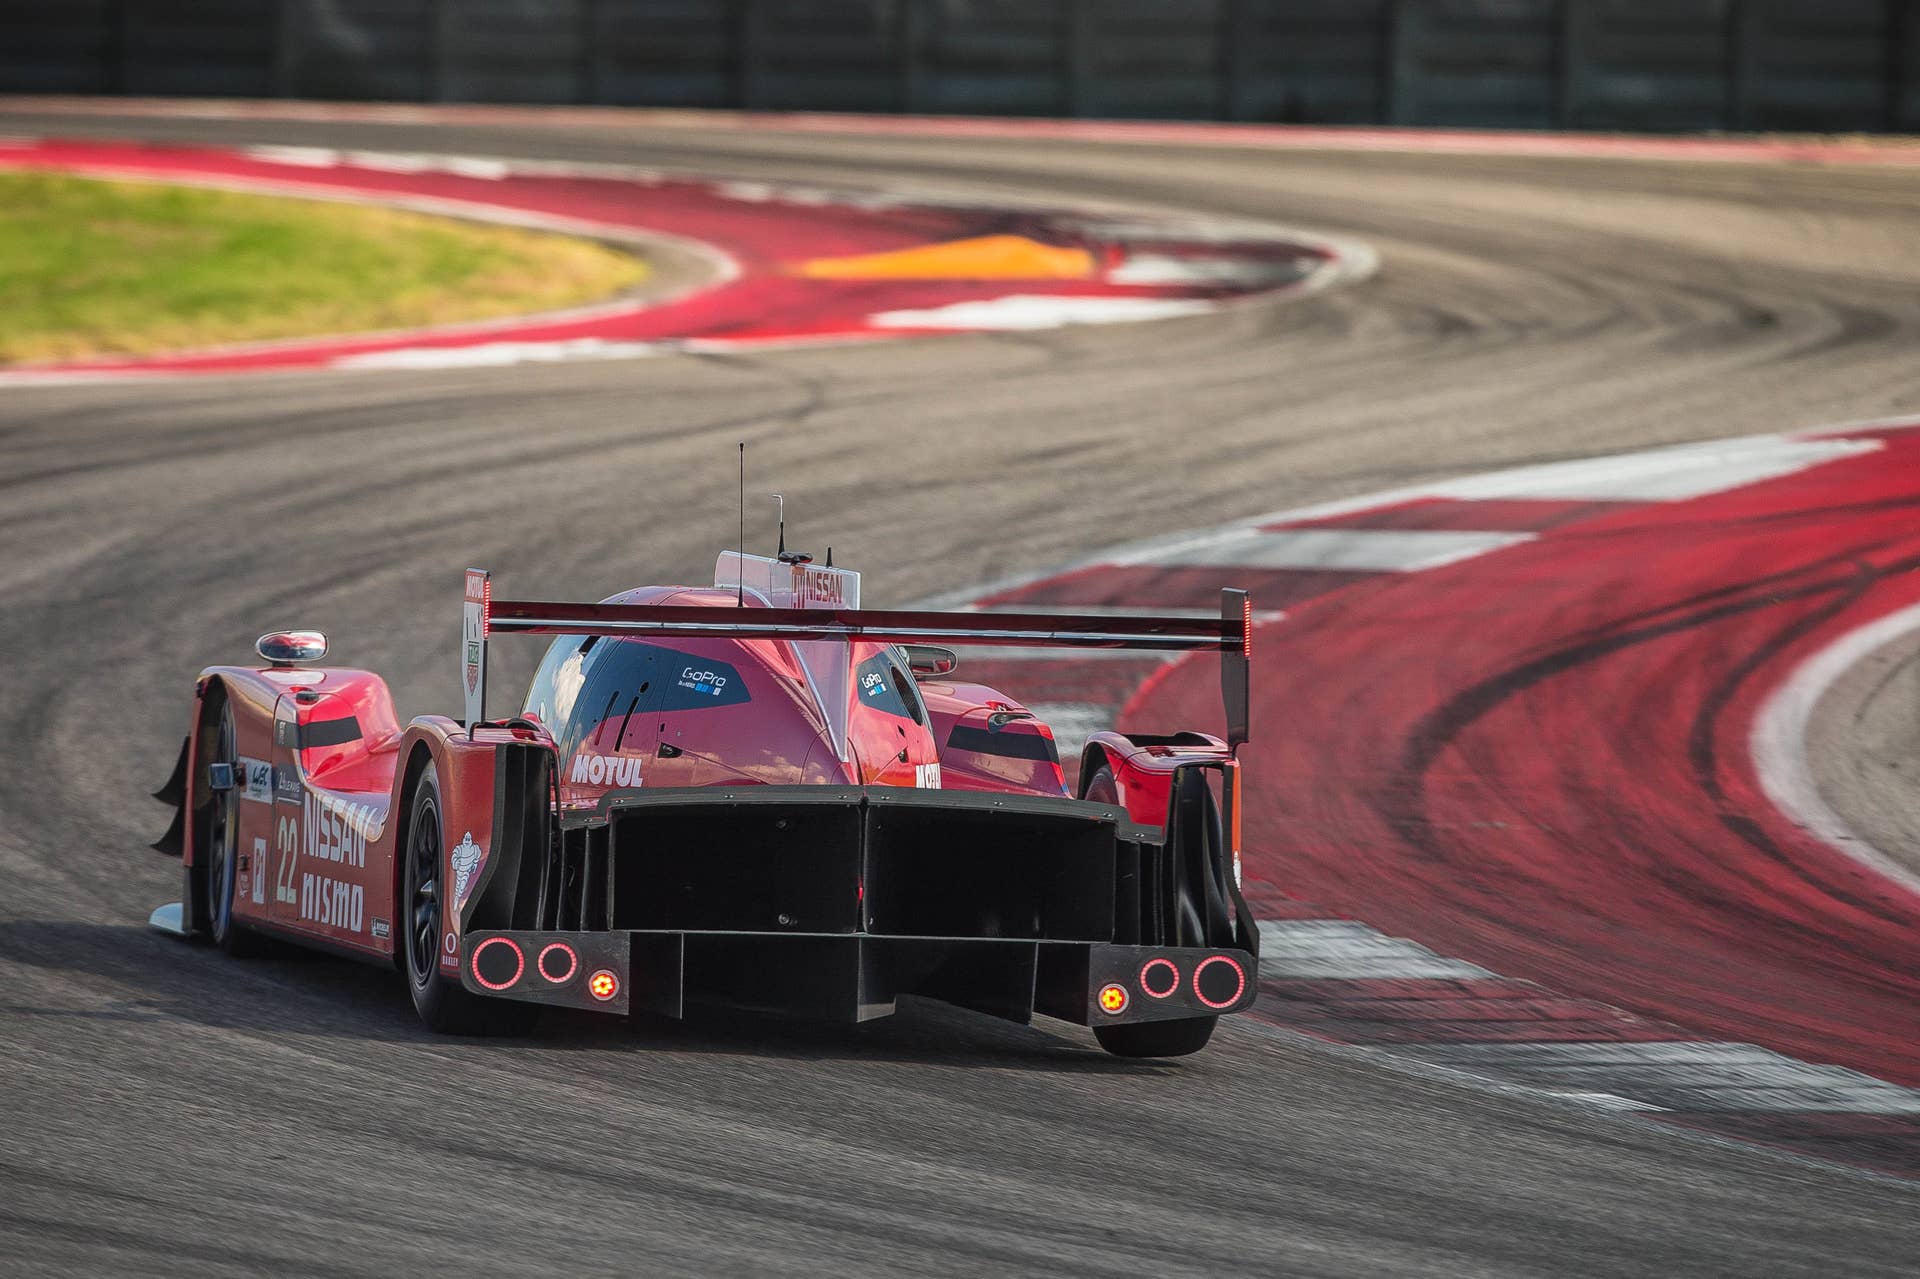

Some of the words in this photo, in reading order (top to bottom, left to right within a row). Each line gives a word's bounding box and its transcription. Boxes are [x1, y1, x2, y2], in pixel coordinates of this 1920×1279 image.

[806, 571, 843, 604] NISSAN
[682, 667, 727, 687] GoPro
[571, 754, 643, 787] MOTUL
[303, 791, 377, 868] NISSAN
[276, 815, 298, 904] 22
